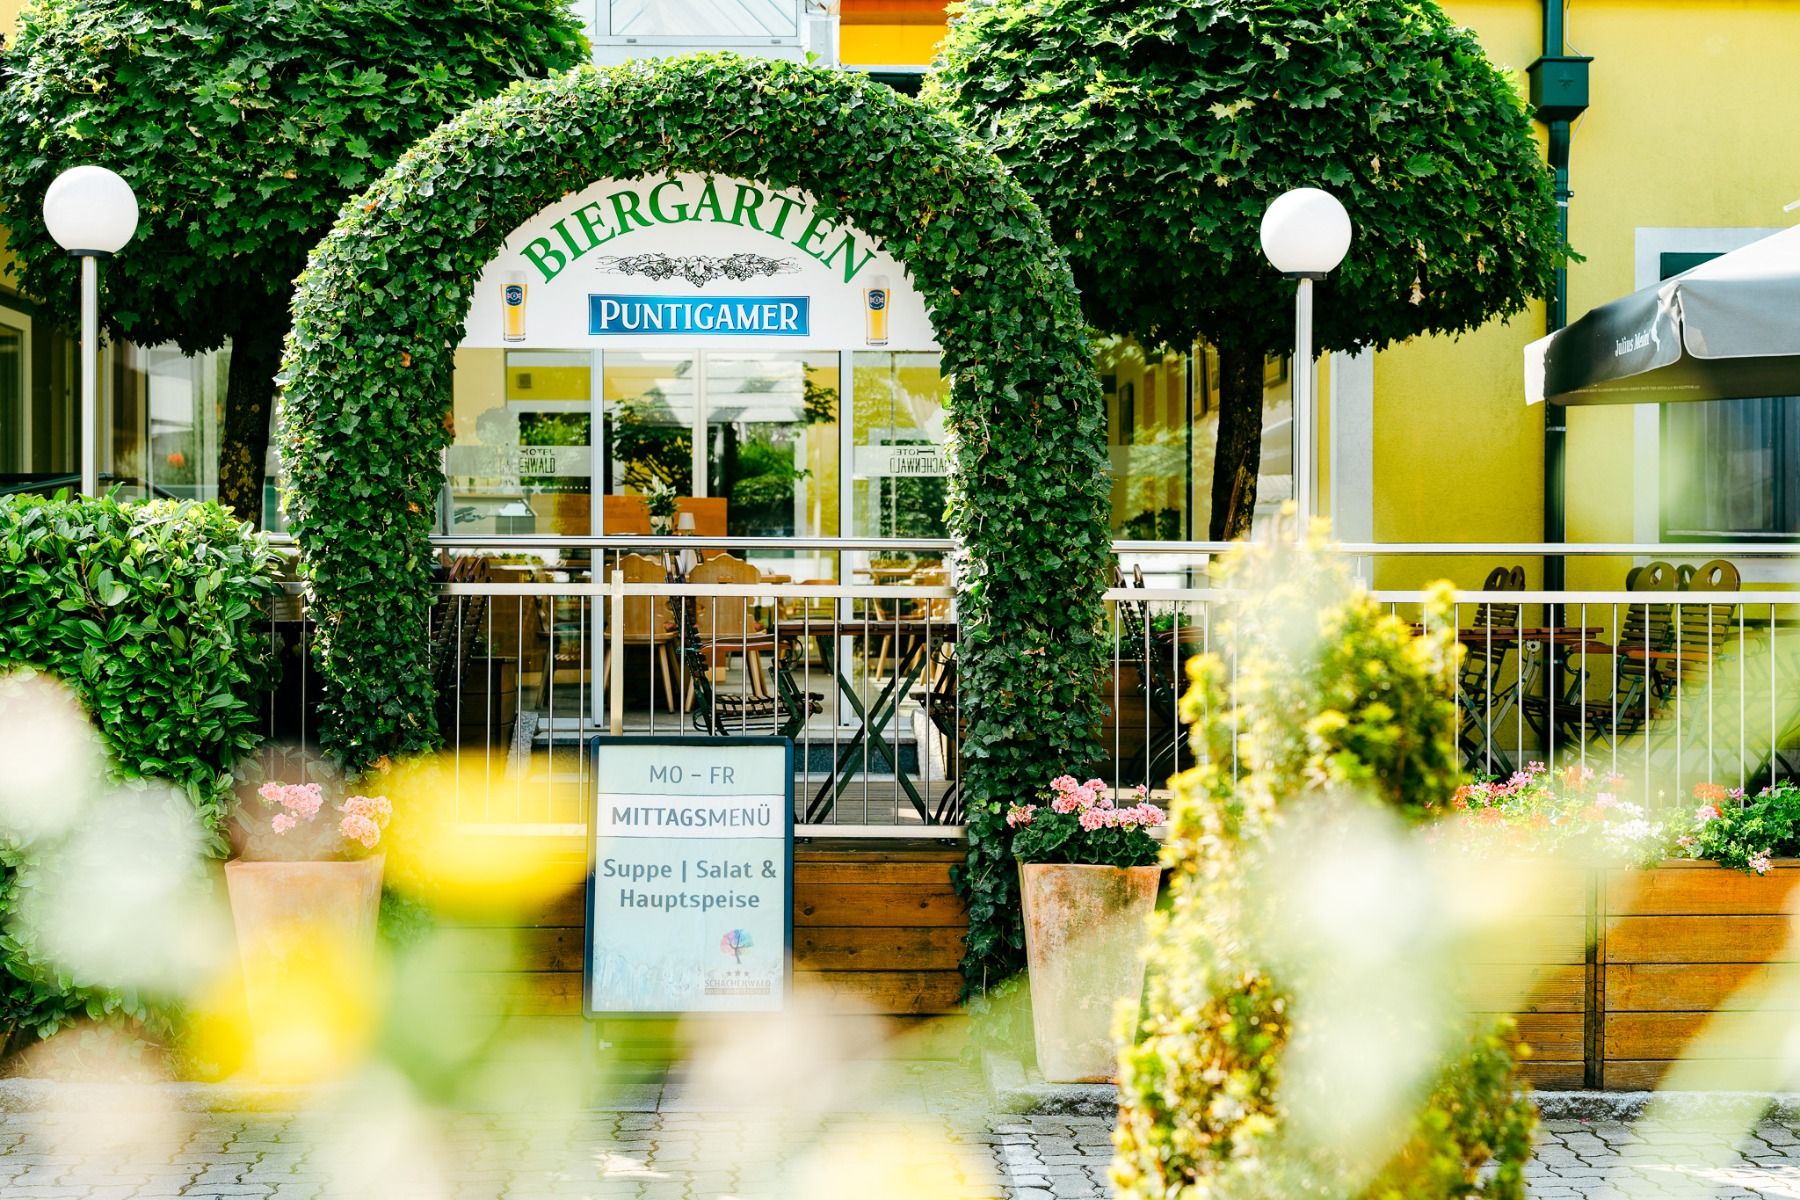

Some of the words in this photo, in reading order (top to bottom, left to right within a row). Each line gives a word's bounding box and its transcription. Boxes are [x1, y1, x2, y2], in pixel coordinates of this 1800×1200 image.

[520, 179, 877, 284] BIERGARTEN
[600, 300, 799, 330] PUNTIGAMER
[650, 765, 683, 784] MO
[710, 766, 735, 784] FR
[611, 803, 771, 827] MITTAGSMENÜ
[603, 858, 673, 883] Suppe
[696, 860, 753, 879] Salat
[761, 859, 777, 879] &
[620, 889, 760, 912] Hauptspeise
